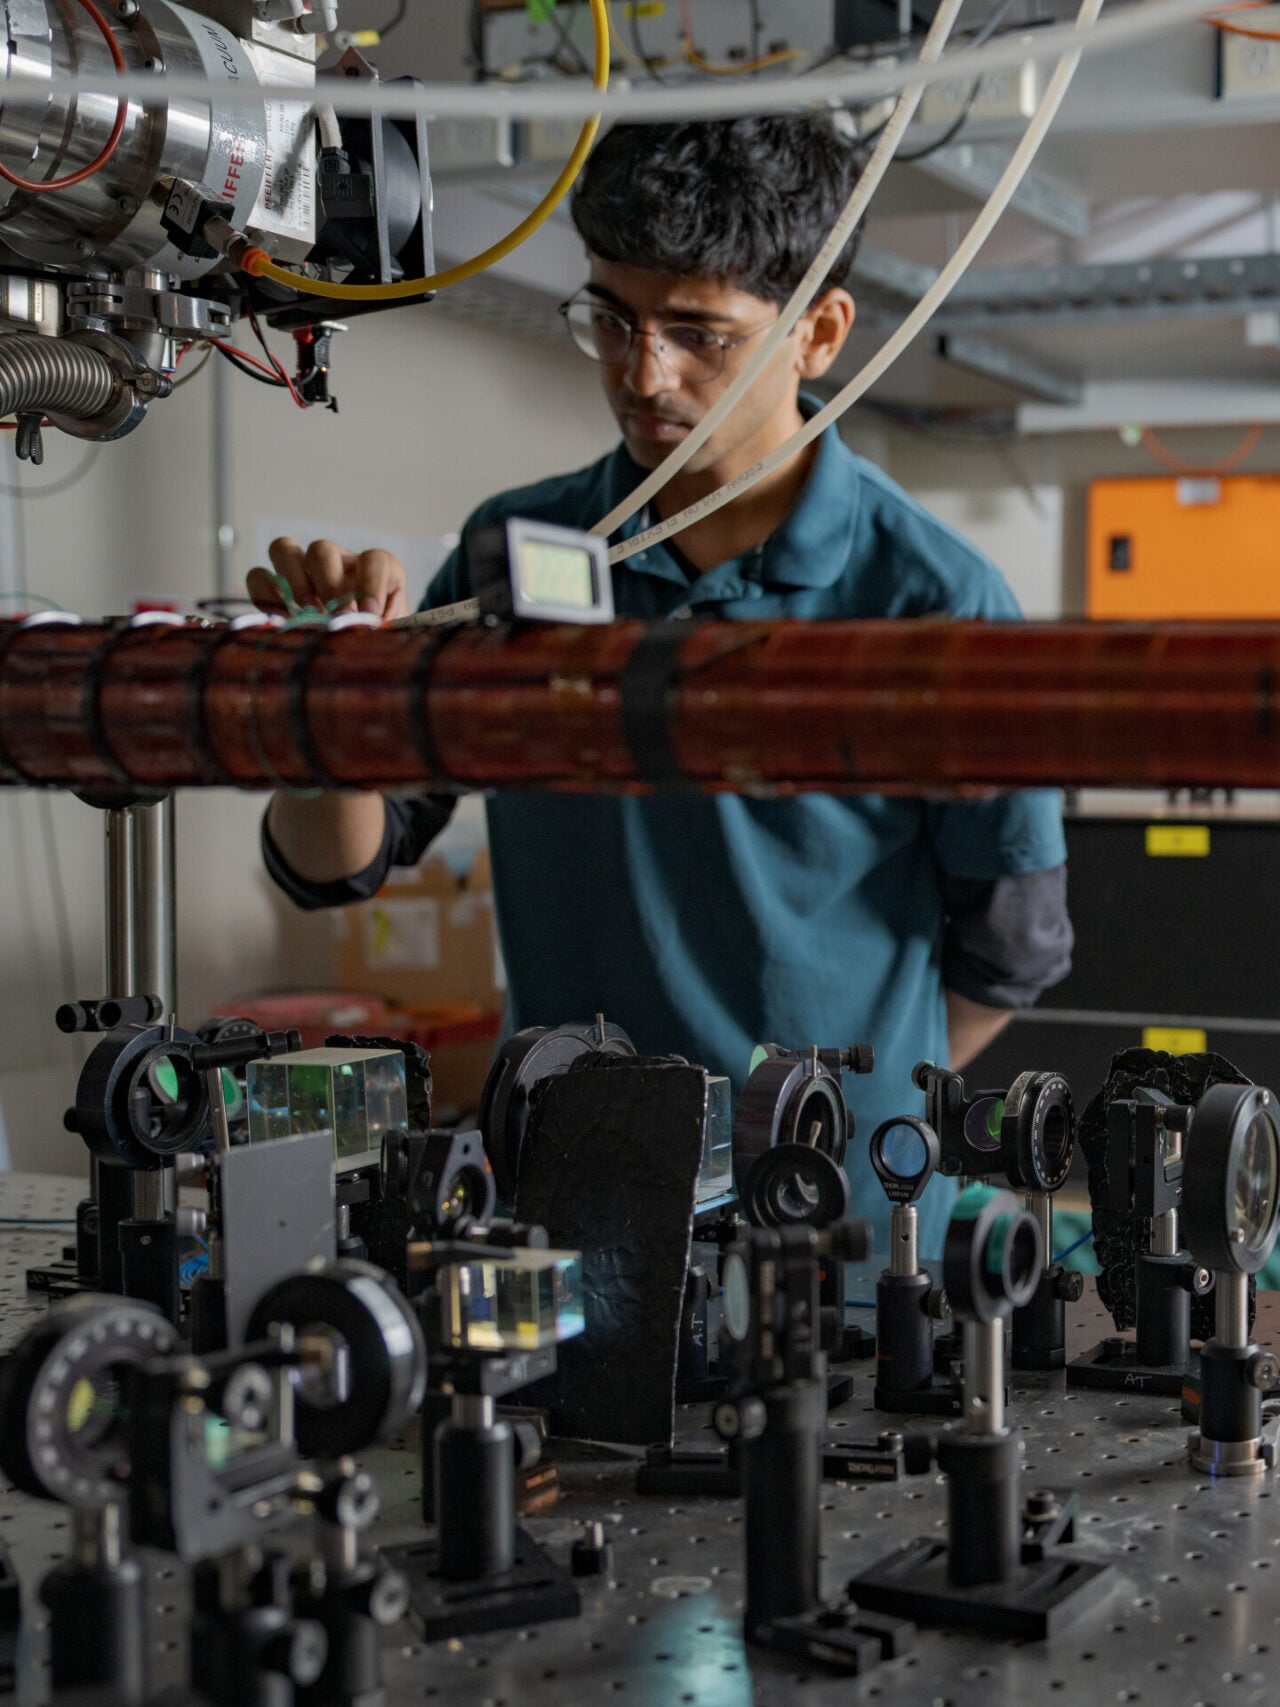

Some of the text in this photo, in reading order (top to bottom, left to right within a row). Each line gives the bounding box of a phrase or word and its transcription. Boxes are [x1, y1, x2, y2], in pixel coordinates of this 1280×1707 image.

[264, 154, 273, 210] PFEIFFER
[428, 607, 460, 622] PSI
[1123, 1373, 1153, 1388] AT
